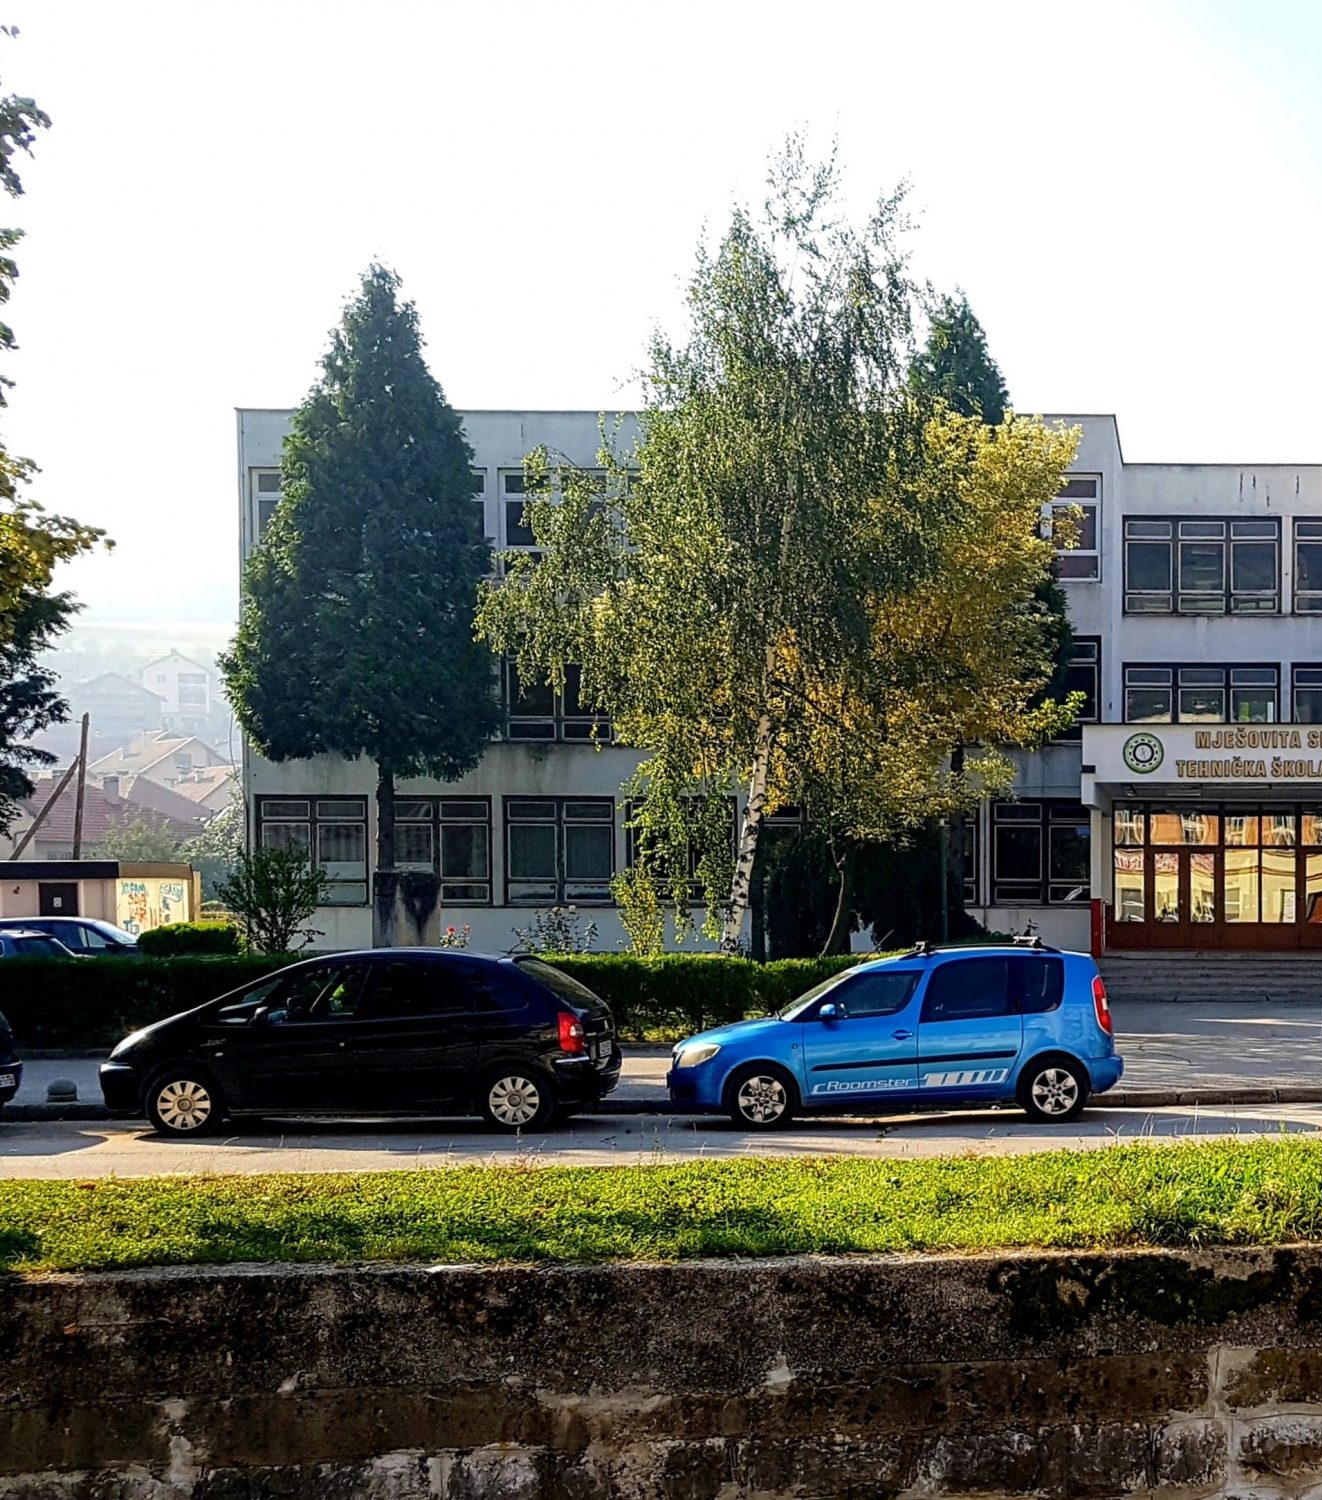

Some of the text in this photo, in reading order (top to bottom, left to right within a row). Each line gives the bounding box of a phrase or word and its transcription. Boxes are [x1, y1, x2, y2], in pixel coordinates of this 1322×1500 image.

[1195, 727, 1301, 749] MJEŠOVITA
[1175, 756, 1267, 778] TEHNIČKA
[827, 1078, 914, 1091] Roomster
